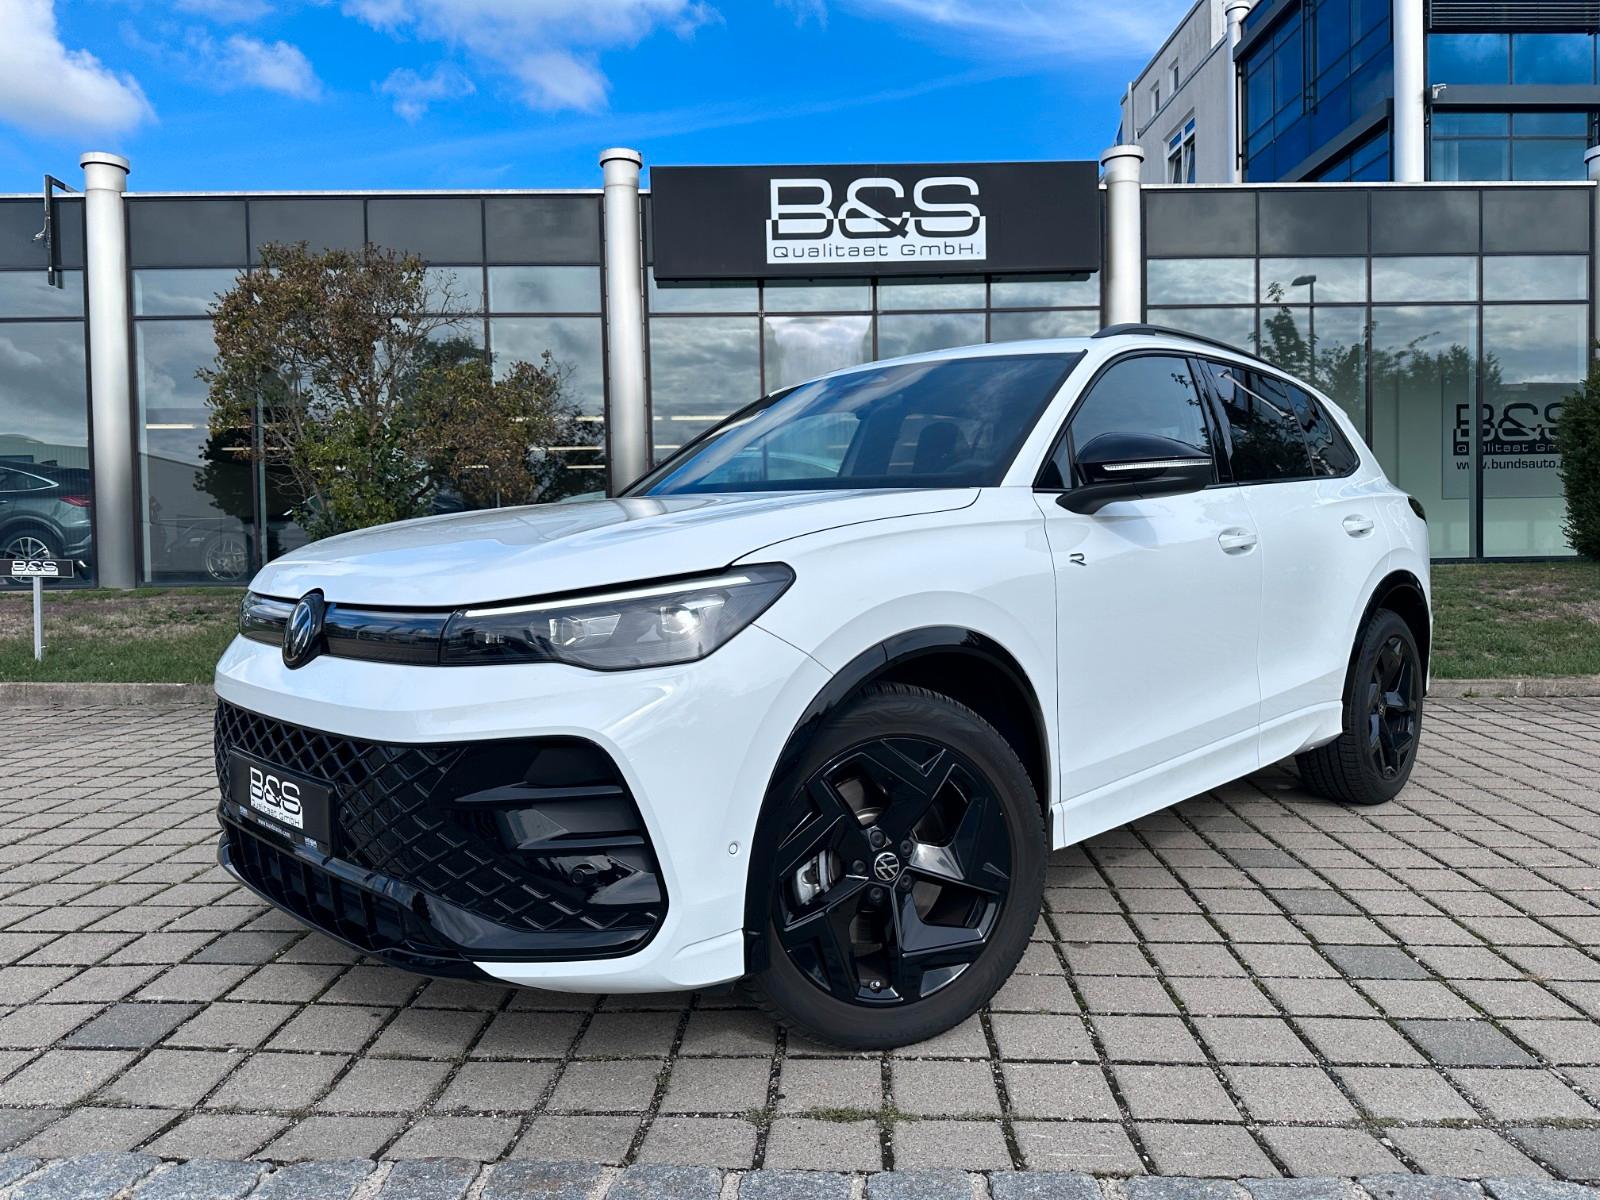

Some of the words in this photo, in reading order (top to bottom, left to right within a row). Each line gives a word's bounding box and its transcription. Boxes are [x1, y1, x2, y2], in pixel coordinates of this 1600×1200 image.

[770, 176, 981, 241] B&S
[773, 243, 889, 258] Qualitaet
[900, 241, 981, 256] GmbH.
[1456, 443, 1529, 453] Qlitaet
[12, 561, 57, 571] B&S
[1070, 553, 1087, 566] R
[250, 767, 302, 816] B&S
